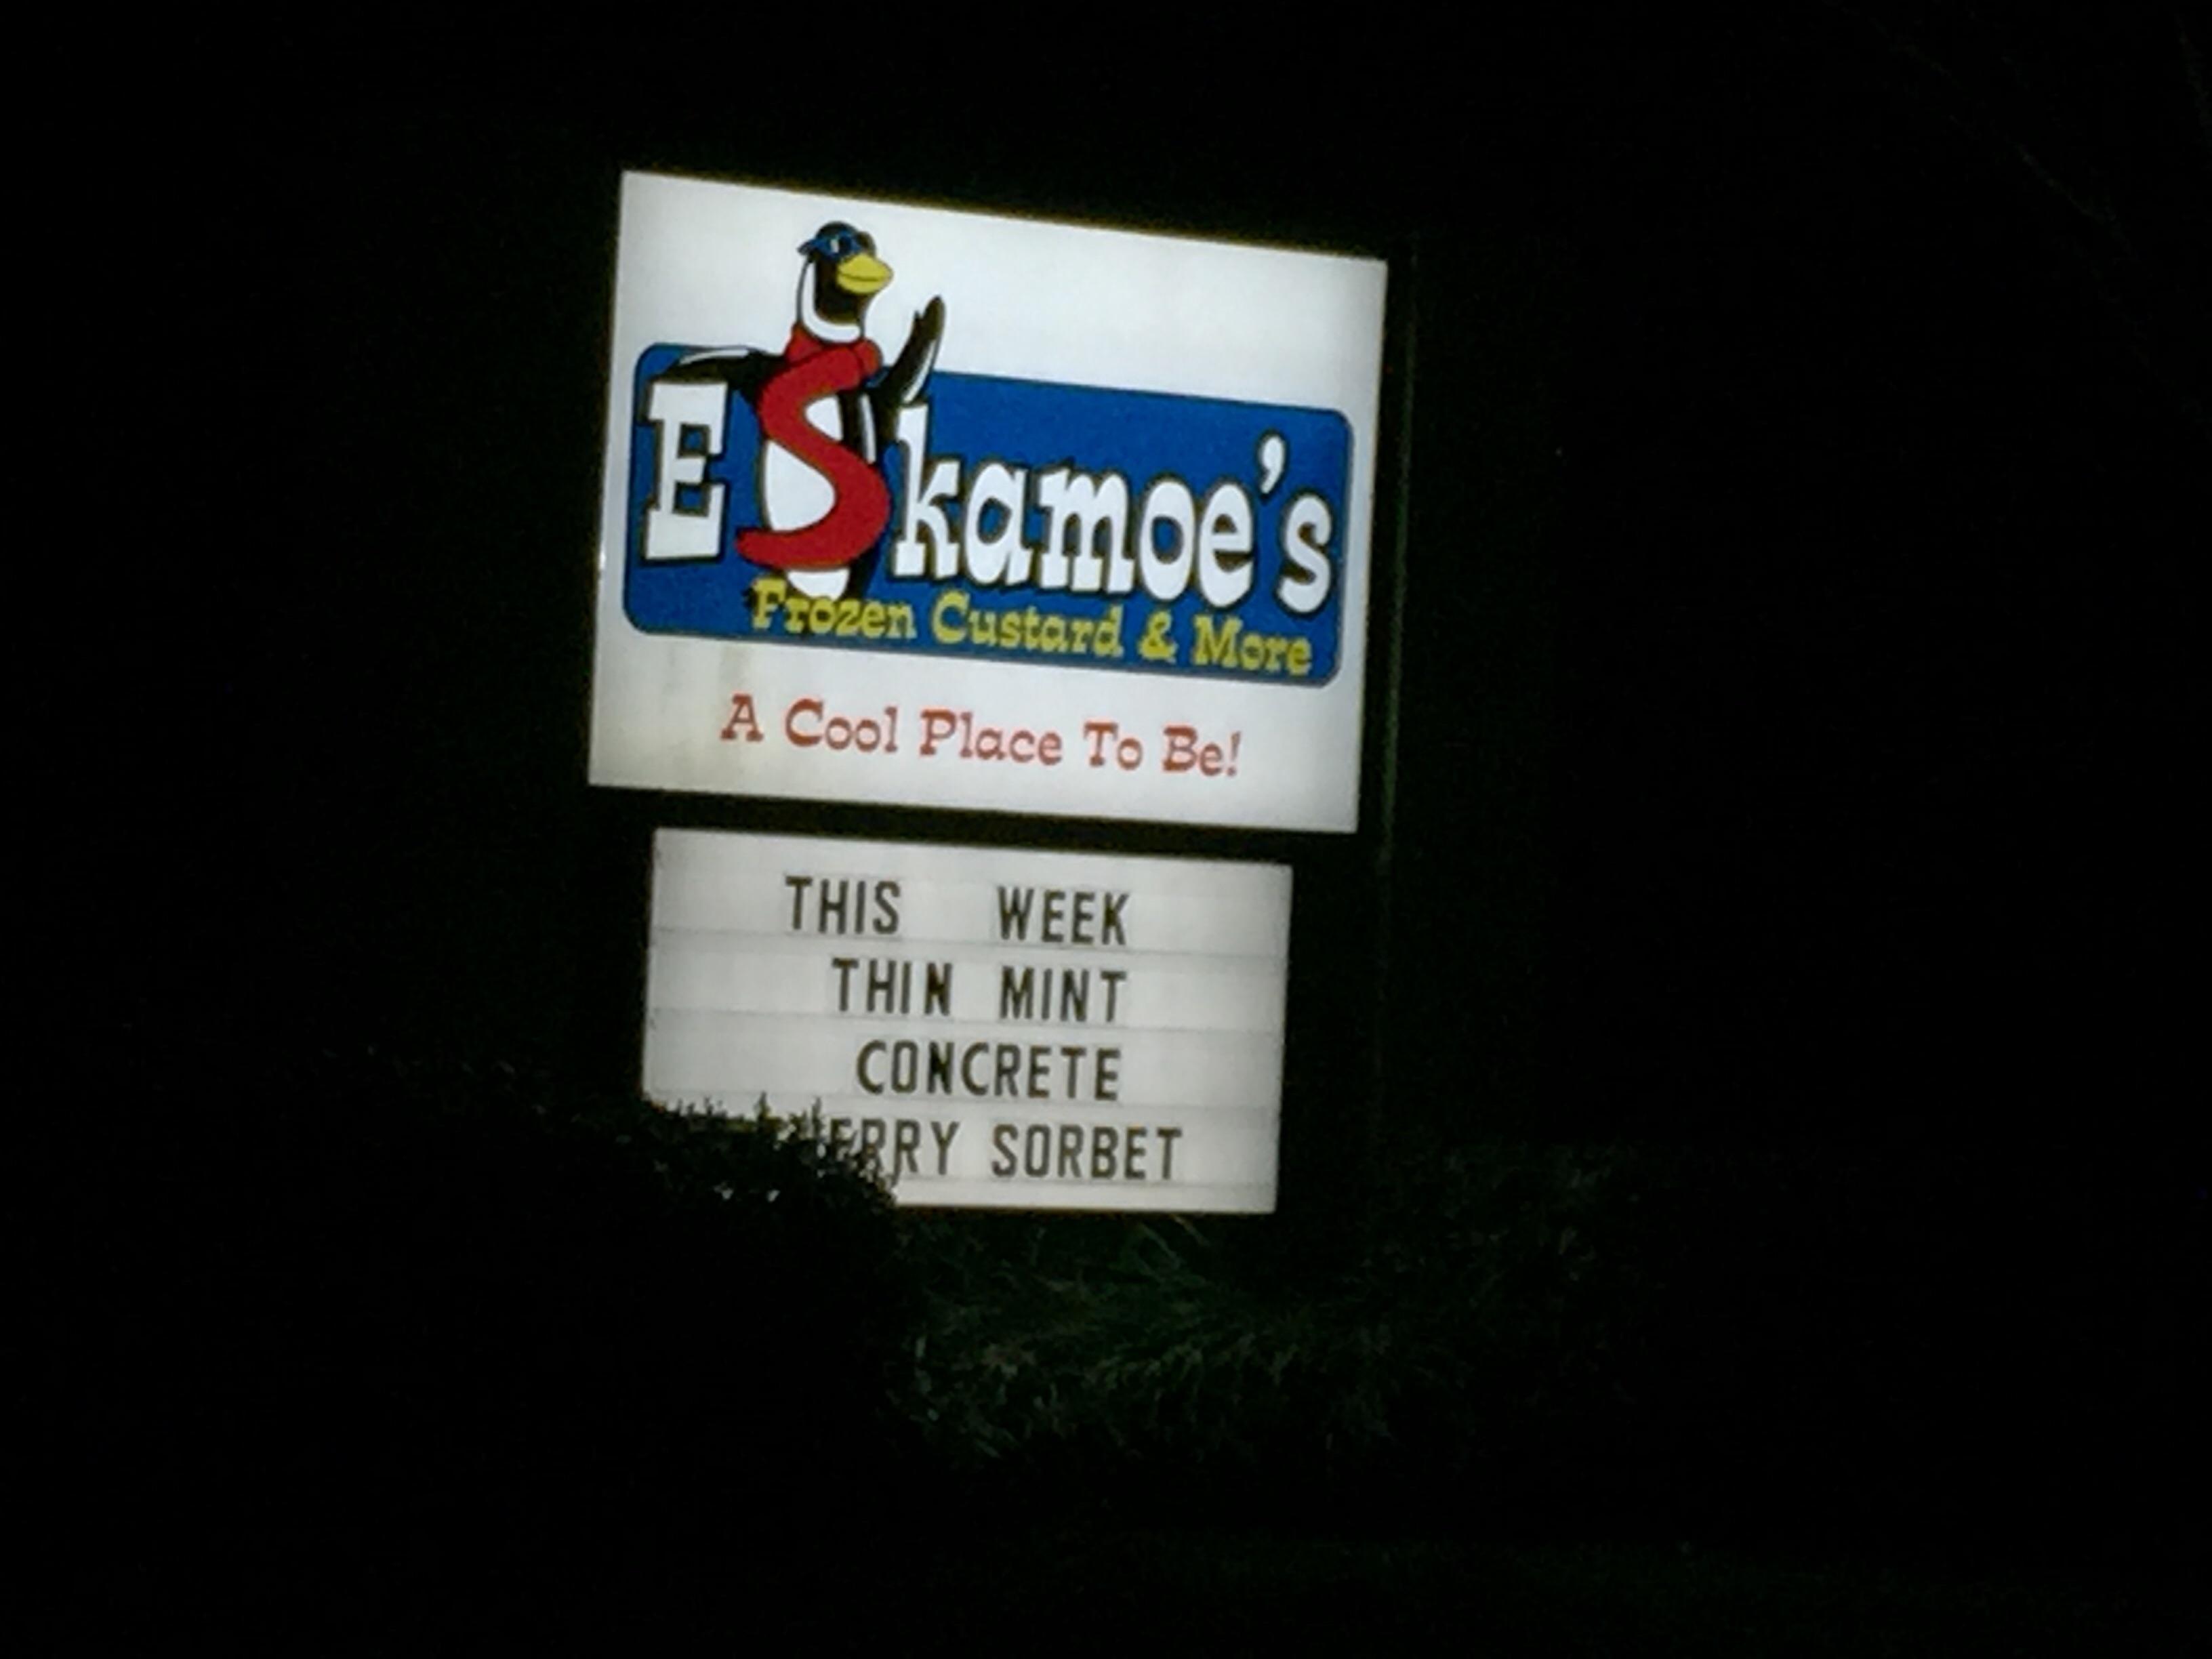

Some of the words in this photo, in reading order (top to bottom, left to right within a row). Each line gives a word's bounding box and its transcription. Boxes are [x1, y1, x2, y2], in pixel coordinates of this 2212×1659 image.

[752, 577, 916, 639] Frozen
[931, 592, 1123, 659] Custard
[1139, 613, 1176, 662] &
[1193, 615, 1311, 676] More
[720, 693, 764, 743] A
[784, 697, 898, 754] Cool
[919, 709, 1062, 766] Place
[1084, 721, 1143, 771] To
[1162, 724, 1244, 777] Be!
[785, 875, 901, 935] THIS
[997, 886, 1130, 946] WEEK
[831, 957, 953, 1016] THIN
[999, 966, 1128, 1023] MINT
[856, 1040, 1122, 1101] CONCRETE
[991, 1123, 1183, 1181] SORBET
